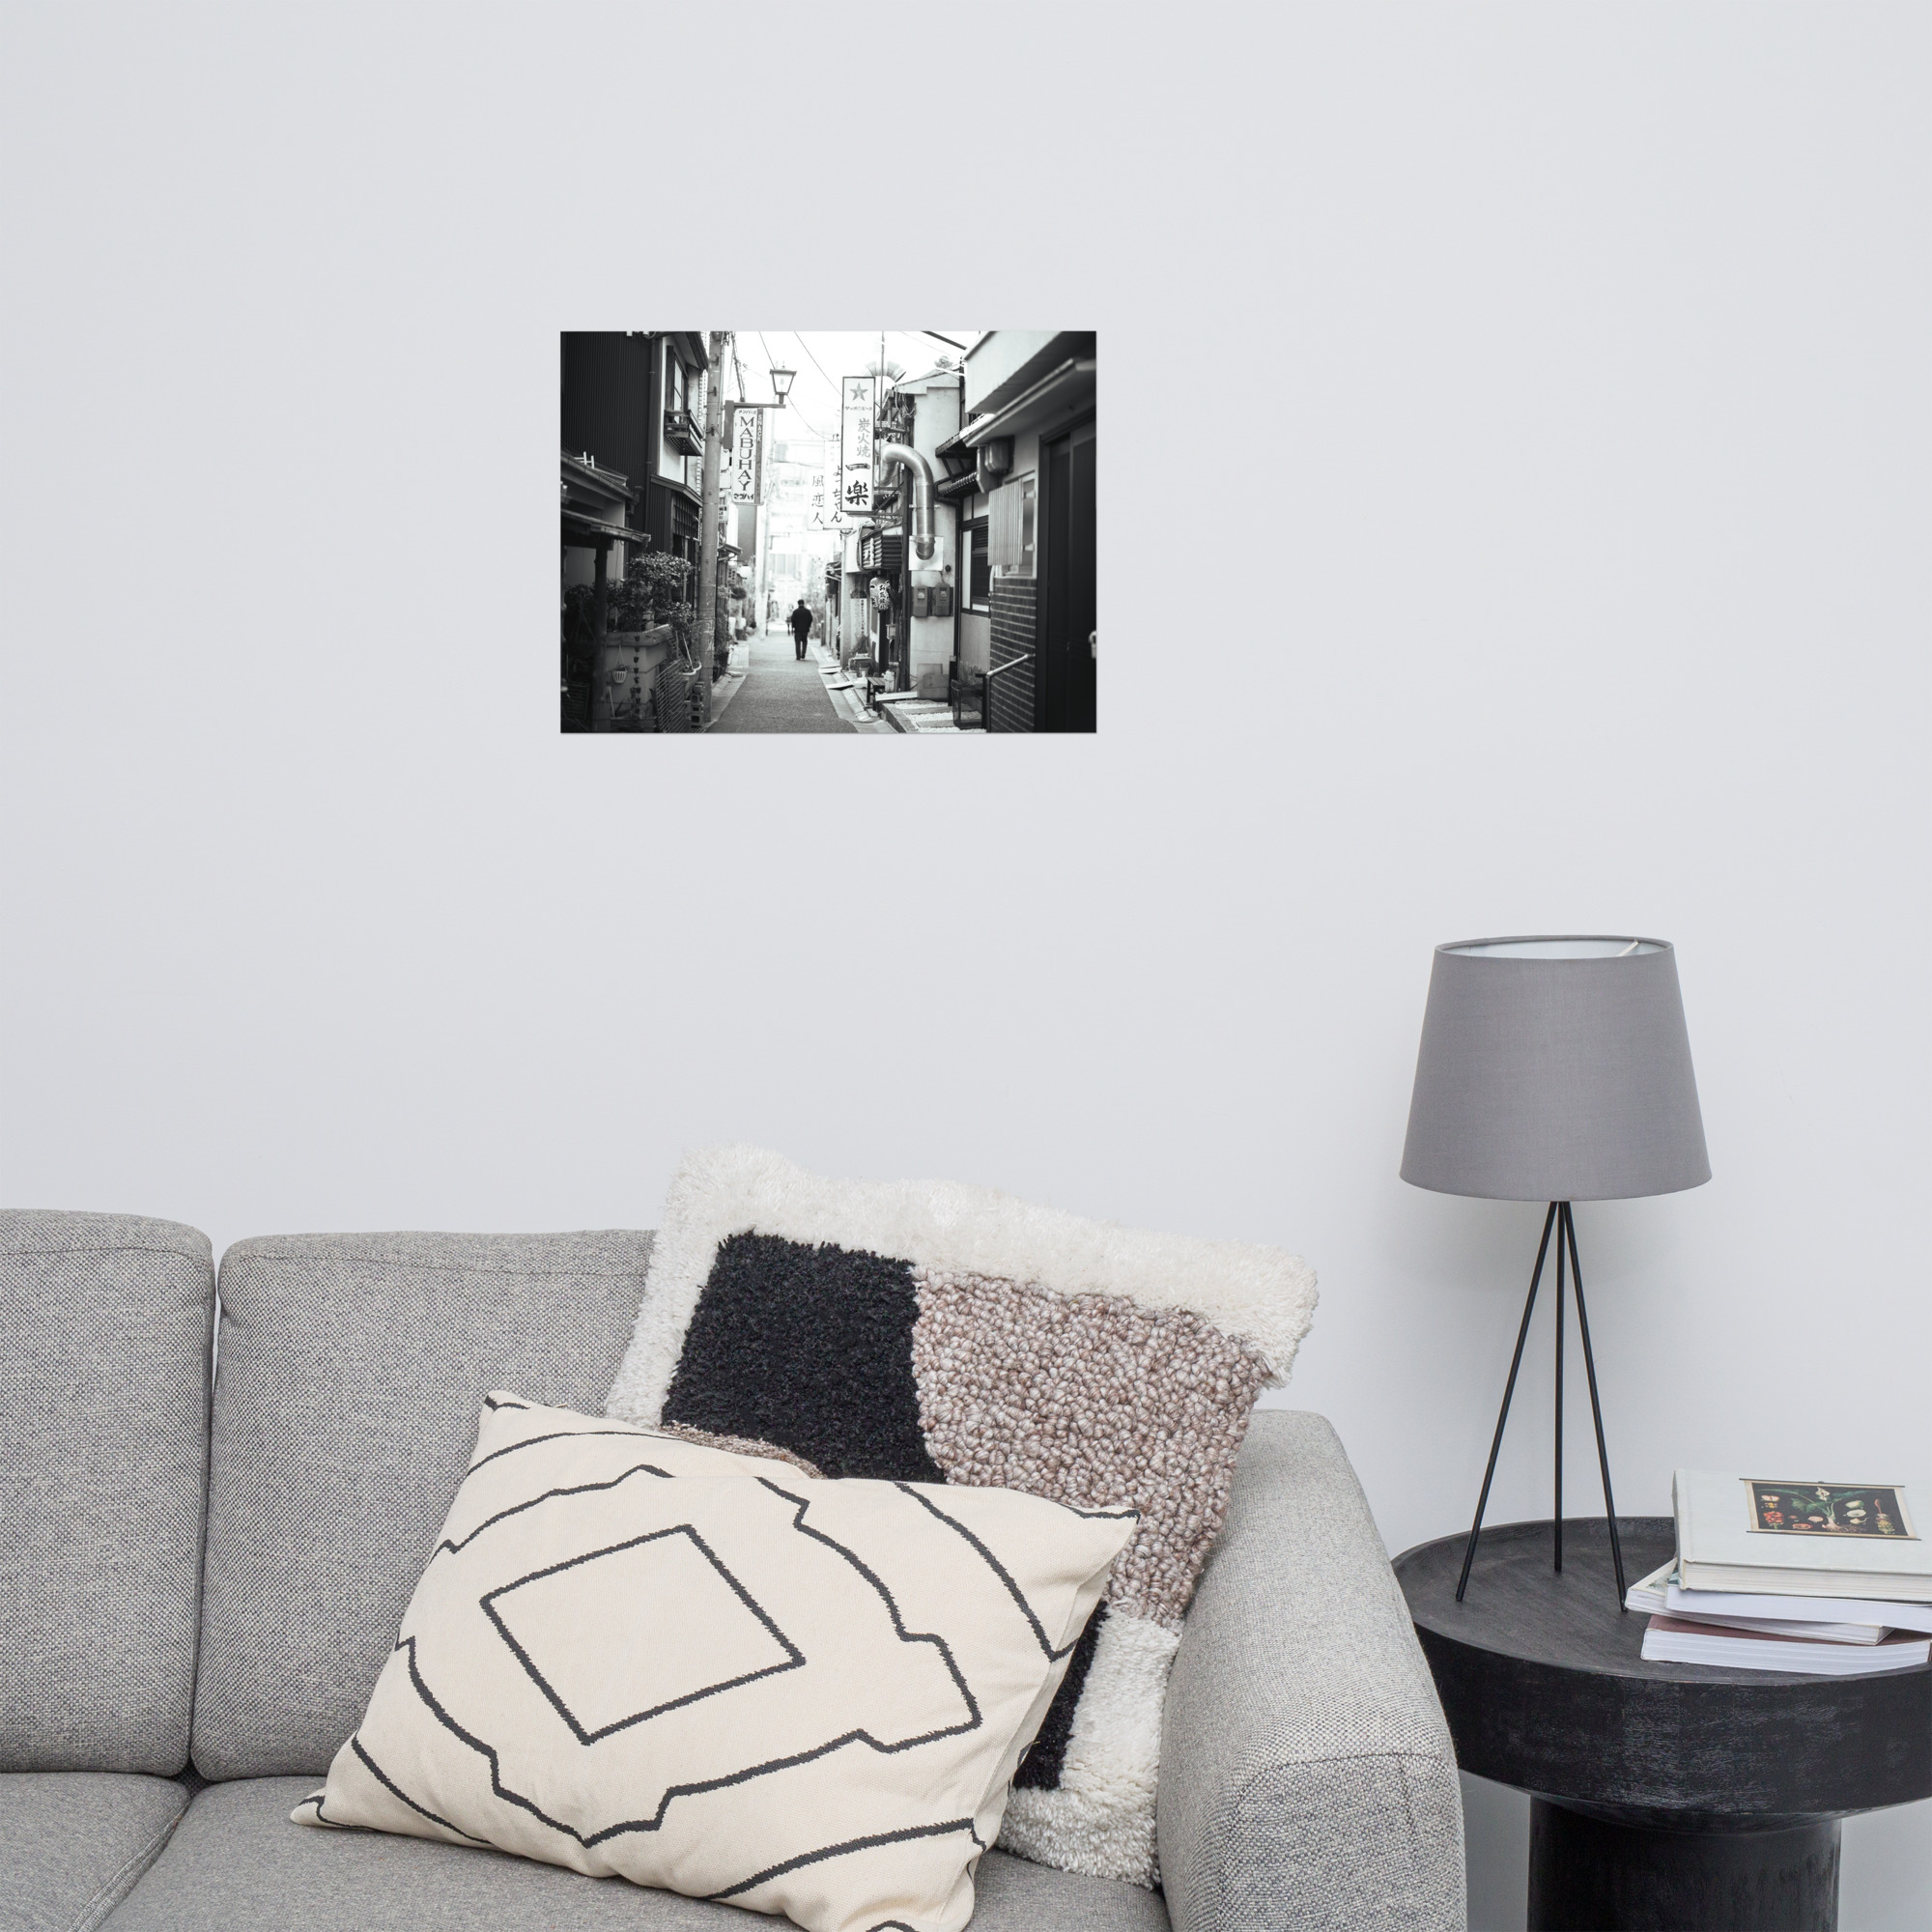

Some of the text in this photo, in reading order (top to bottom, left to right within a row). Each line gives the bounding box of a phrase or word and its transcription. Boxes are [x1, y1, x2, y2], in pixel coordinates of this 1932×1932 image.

[737, 415, 754, 491] MABUHAY
[856, 417, 871, 458] 炭火焼
[844, 463, 871, 506] 一楽
